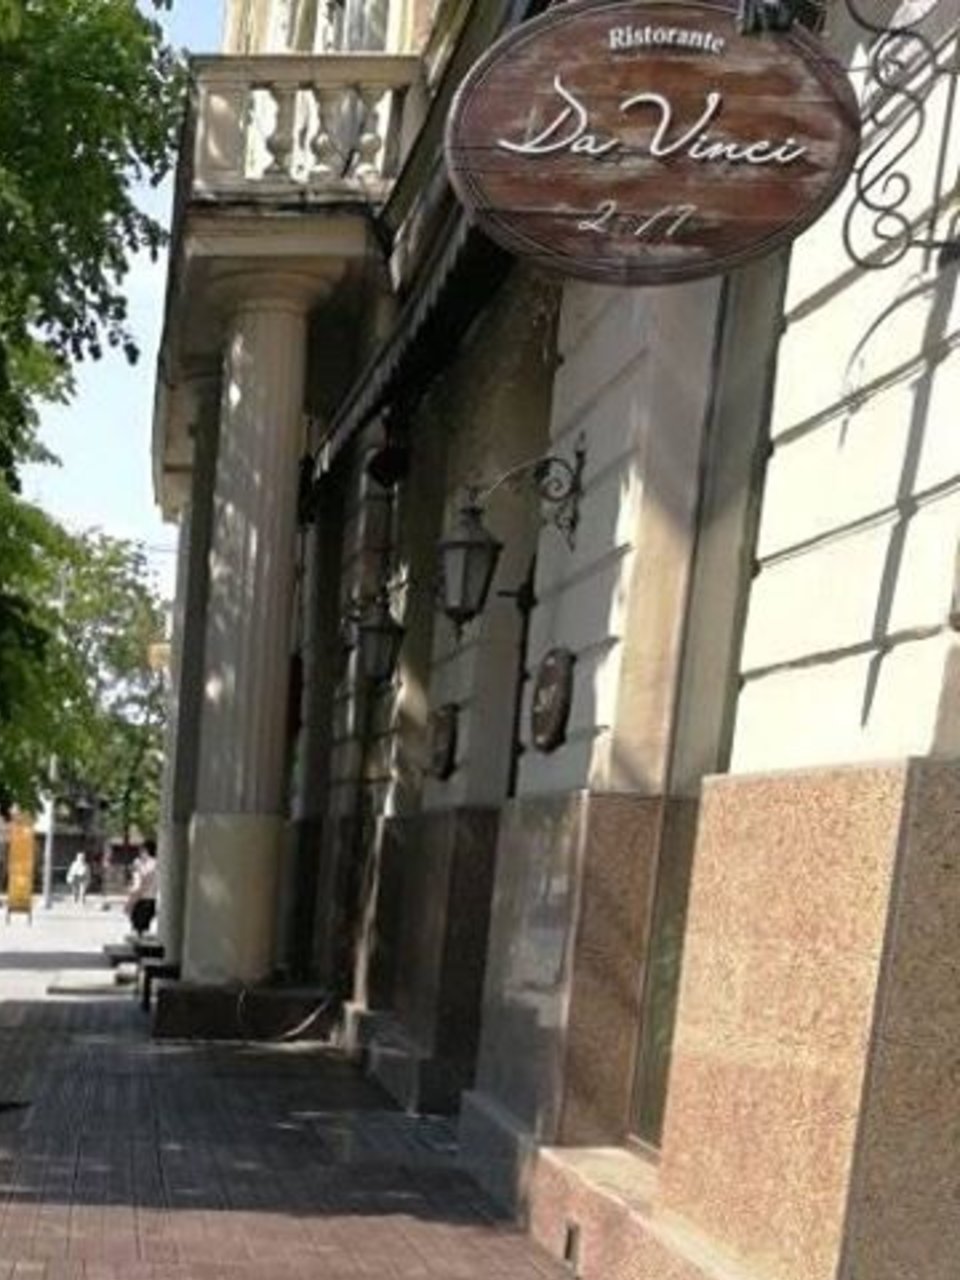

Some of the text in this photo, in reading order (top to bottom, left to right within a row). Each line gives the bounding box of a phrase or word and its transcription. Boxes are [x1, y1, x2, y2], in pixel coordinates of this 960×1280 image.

[609, 25, 725, 54] Ristorante
[498, 75, 807, 163] Da Vinci
